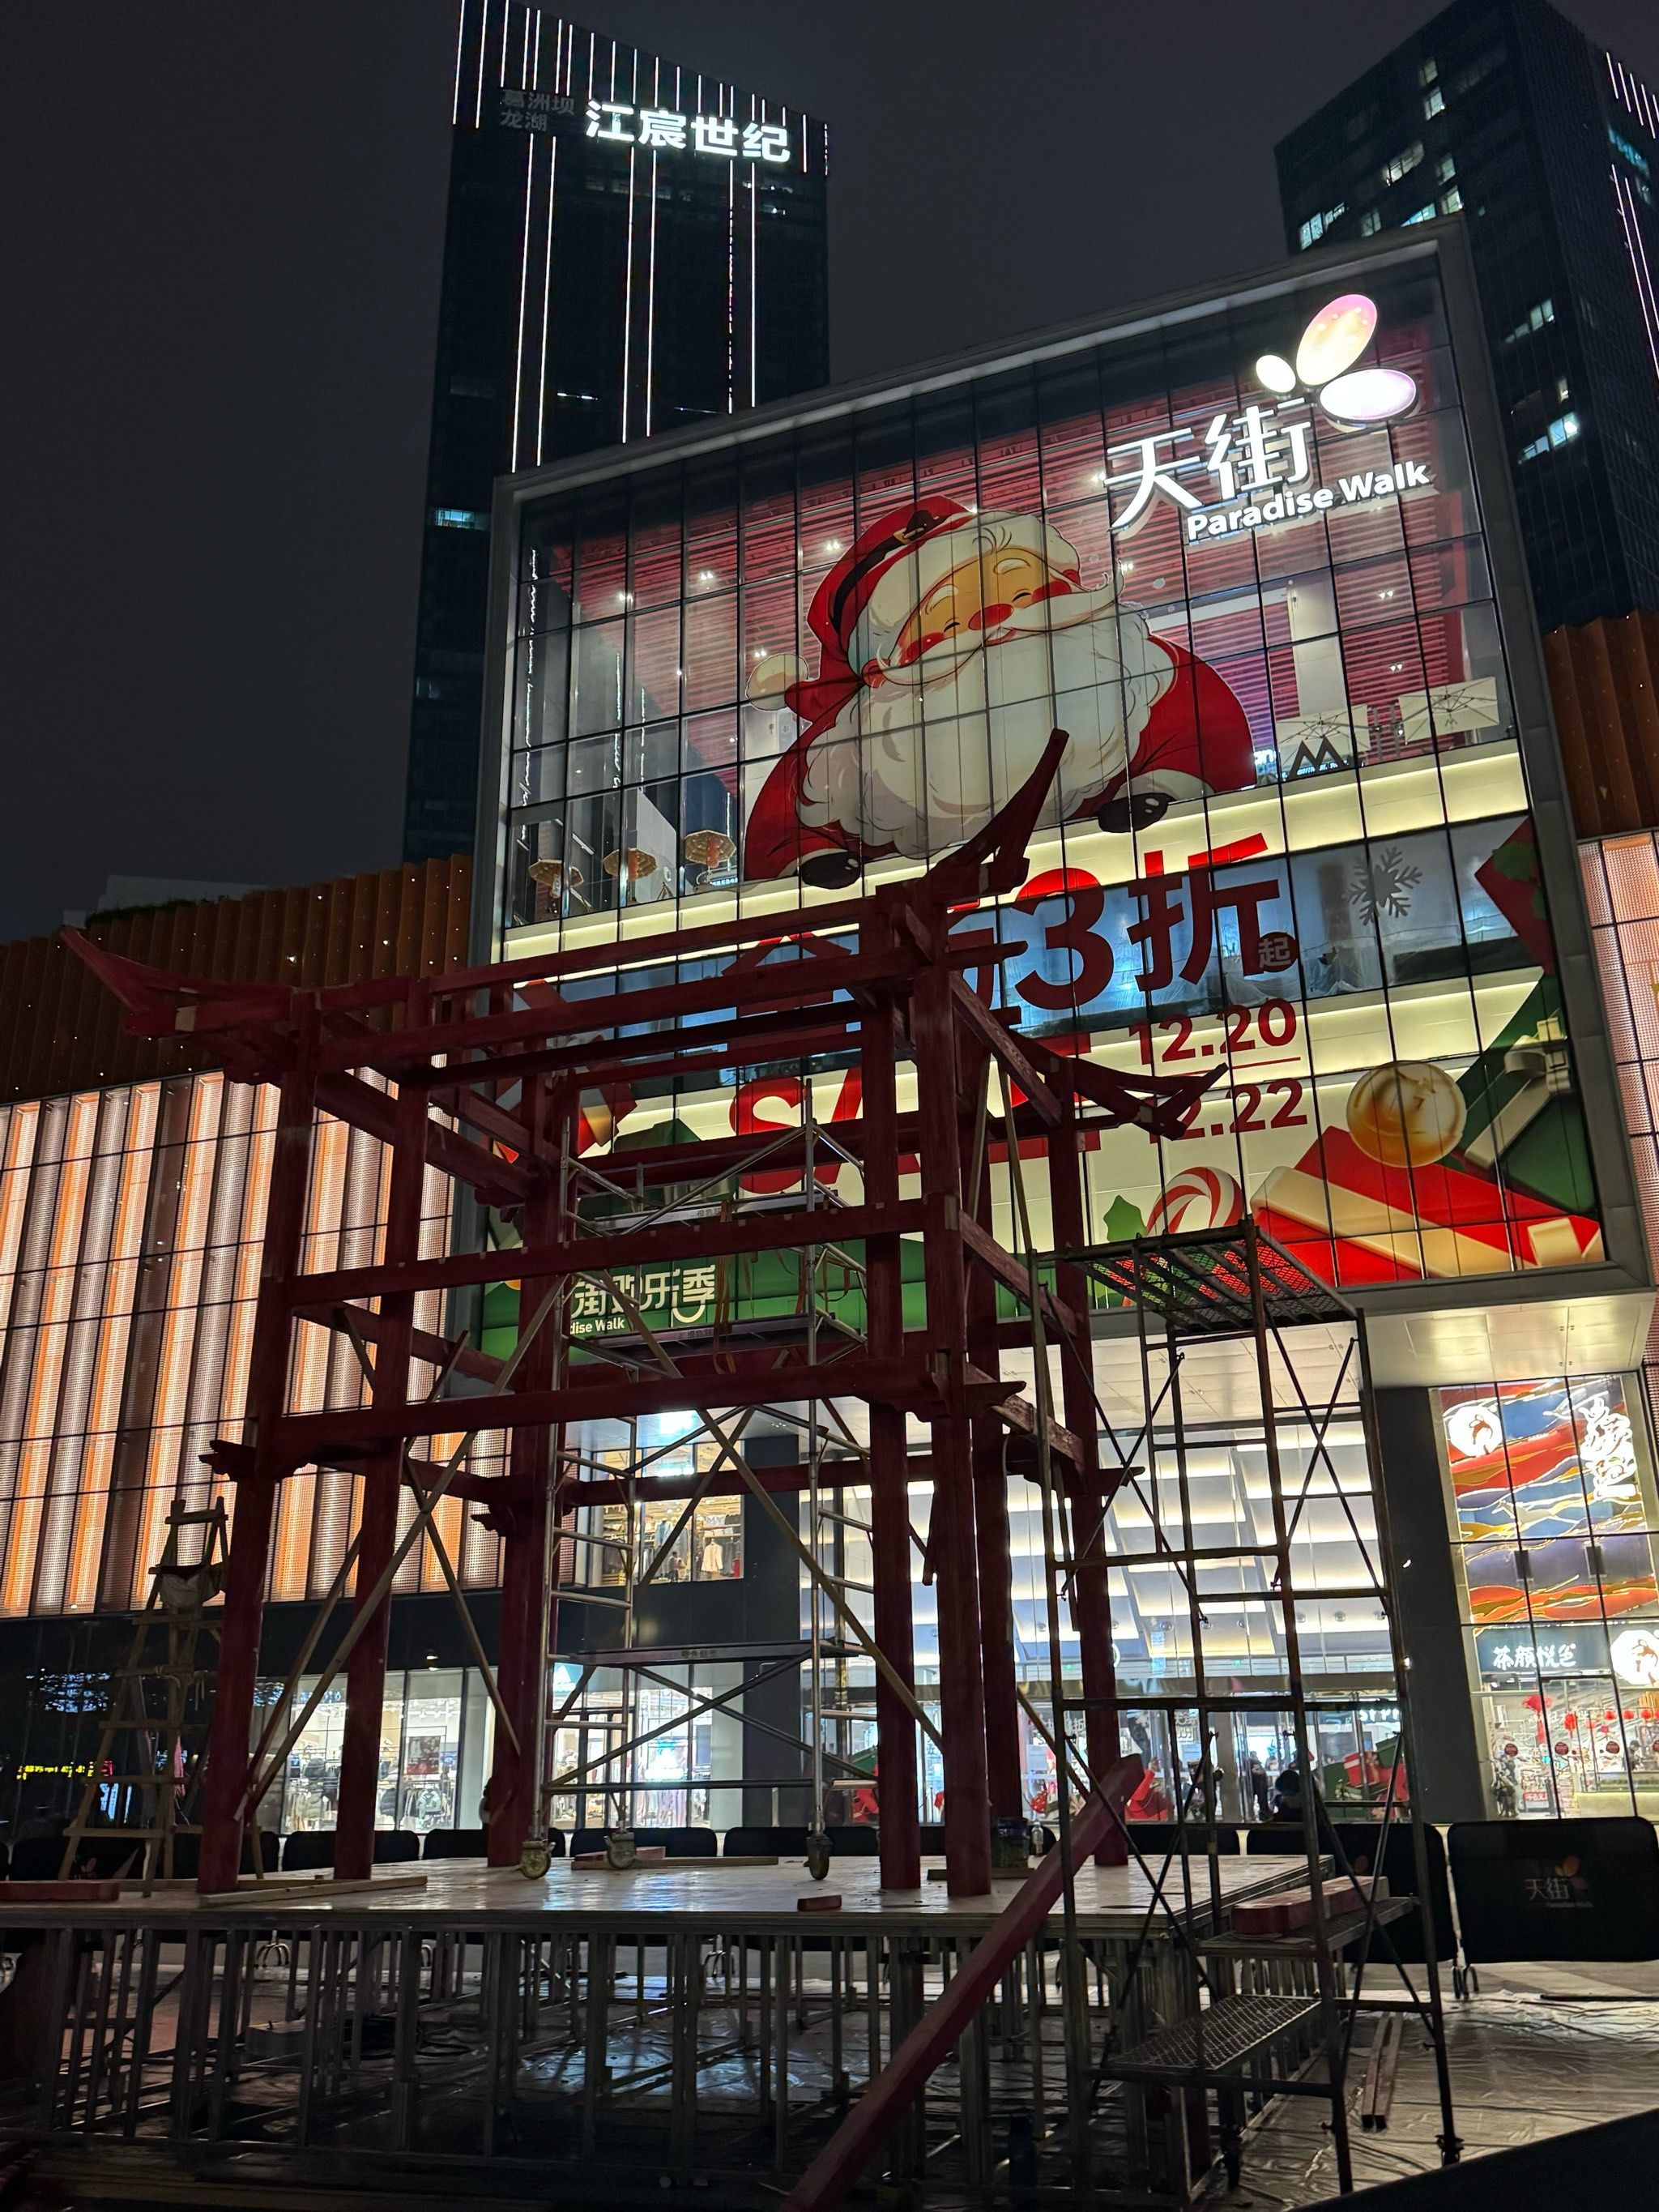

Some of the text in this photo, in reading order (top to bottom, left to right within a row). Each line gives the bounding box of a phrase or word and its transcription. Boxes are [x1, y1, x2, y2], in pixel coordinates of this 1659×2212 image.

[500, 109, 548, 132] 龙湖
[585, 99, 791, 163] 江宸世纪
[1104, 397, 1311, 532] 天街
[1188, 459, 1430, 541] Paradise Walk
[1257, 937, 1291, 969] 起
[1128, 997, 1296, 1065] 12.20
[1143, 1078, 1307, 1144] 2.22
[595, 1317, 625, 1331] Walk
[1493, 1643, 1576, 1671] 茶颜悦色
[1524, 1877, 1570, 1901] 天街
